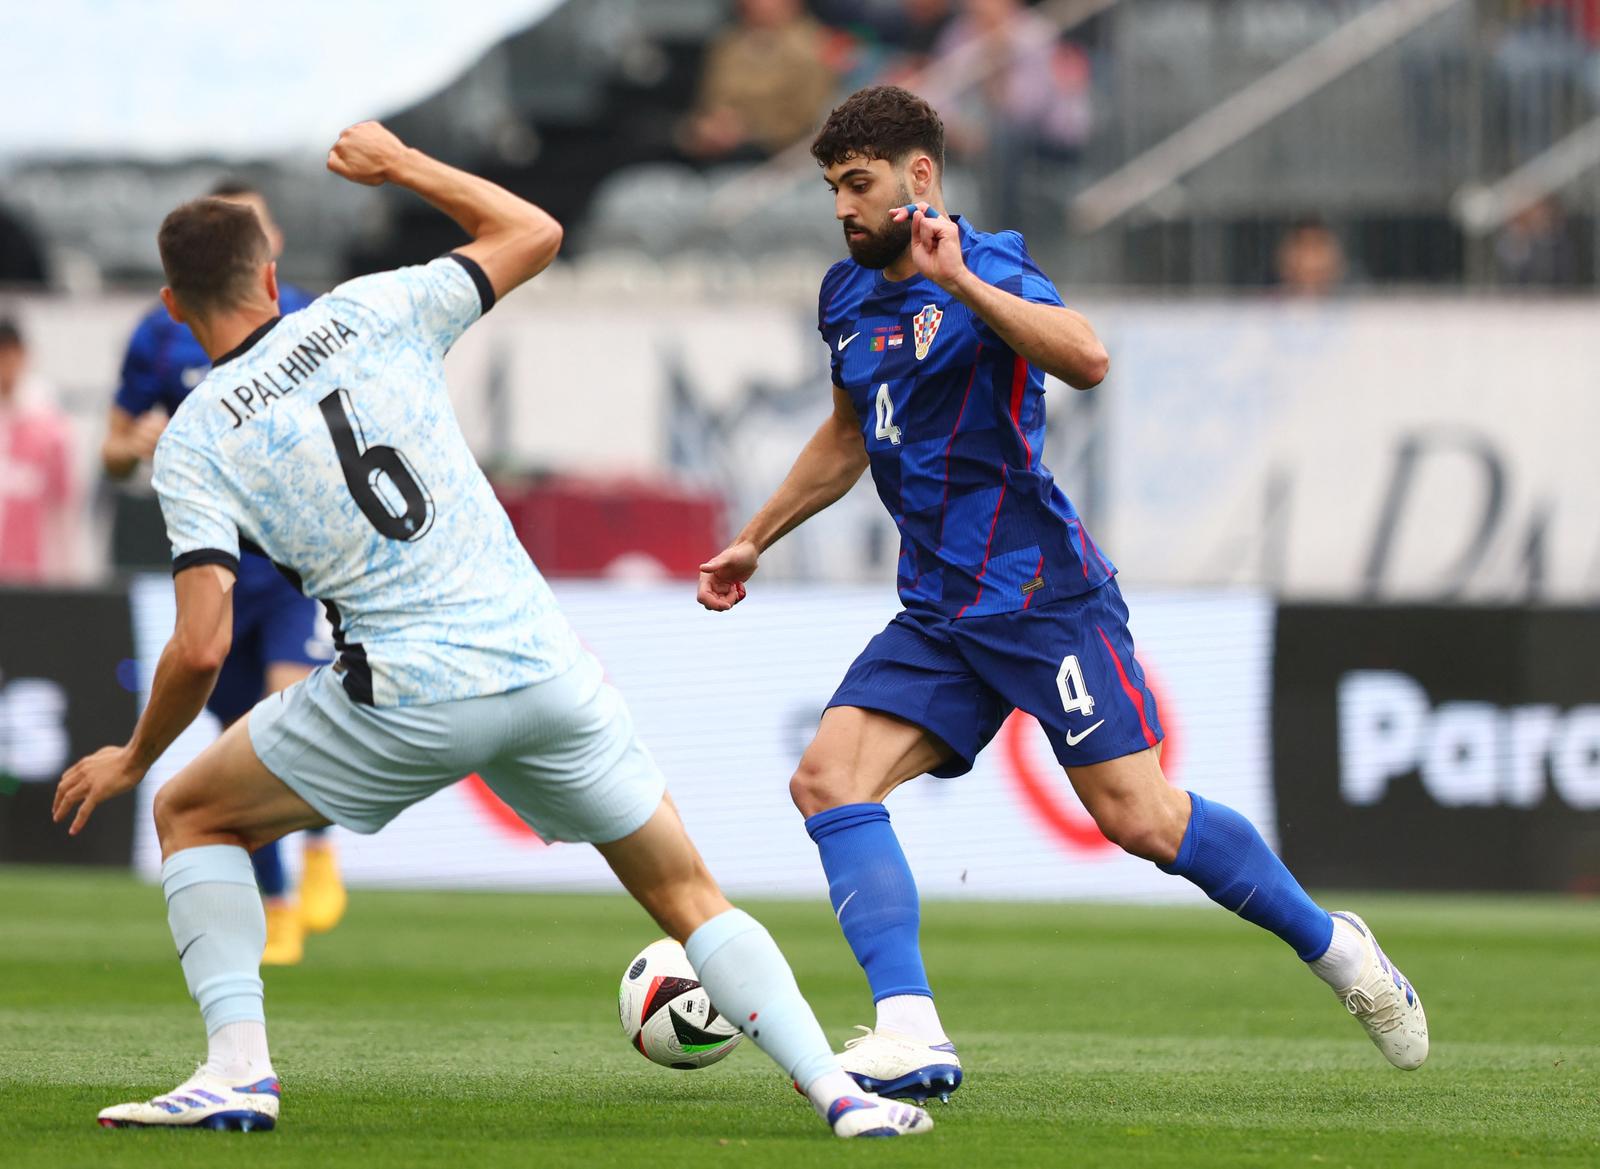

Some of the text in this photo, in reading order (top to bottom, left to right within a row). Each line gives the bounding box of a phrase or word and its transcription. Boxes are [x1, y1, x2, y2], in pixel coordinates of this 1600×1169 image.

[220, 318, 358, 429] J.PALHINHA
[875, 383, 902, 445] 4
[318, 387, 436, 543] 6
[1056, 654, 1095, 717] 4
